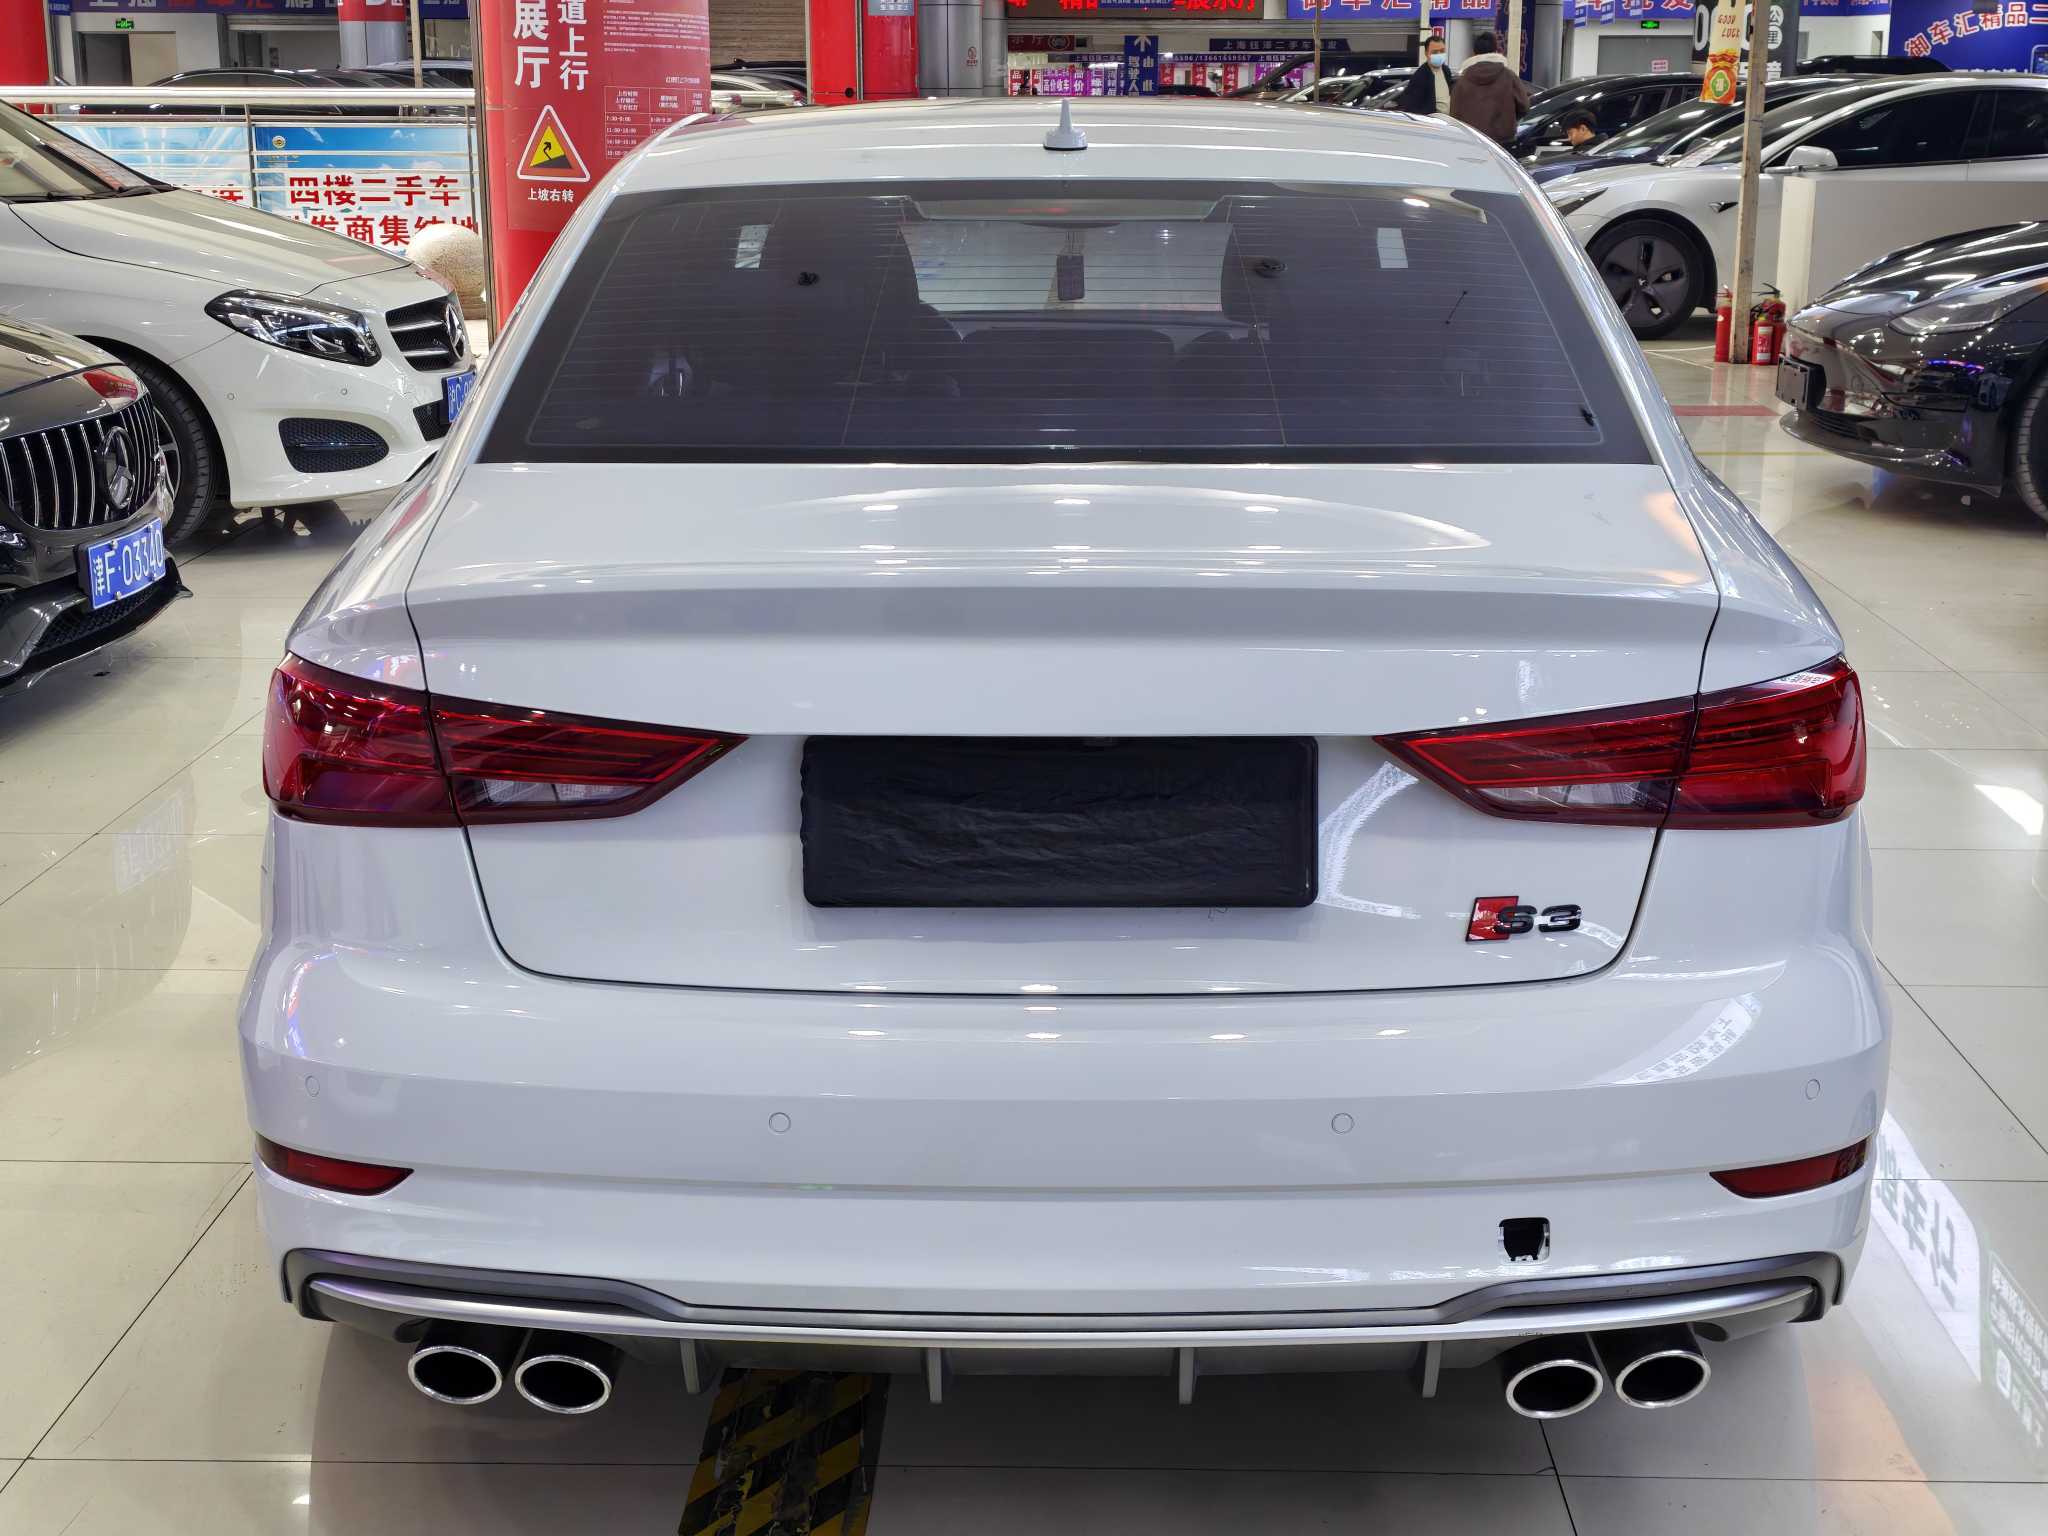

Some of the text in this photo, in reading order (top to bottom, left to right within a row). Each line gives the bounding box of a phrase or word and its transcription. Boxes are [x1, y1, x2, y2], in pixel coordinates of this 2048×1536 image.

[289, 174, 461, 206] 四楼二手车
[527, 187, 575, 203] 上坡右转
